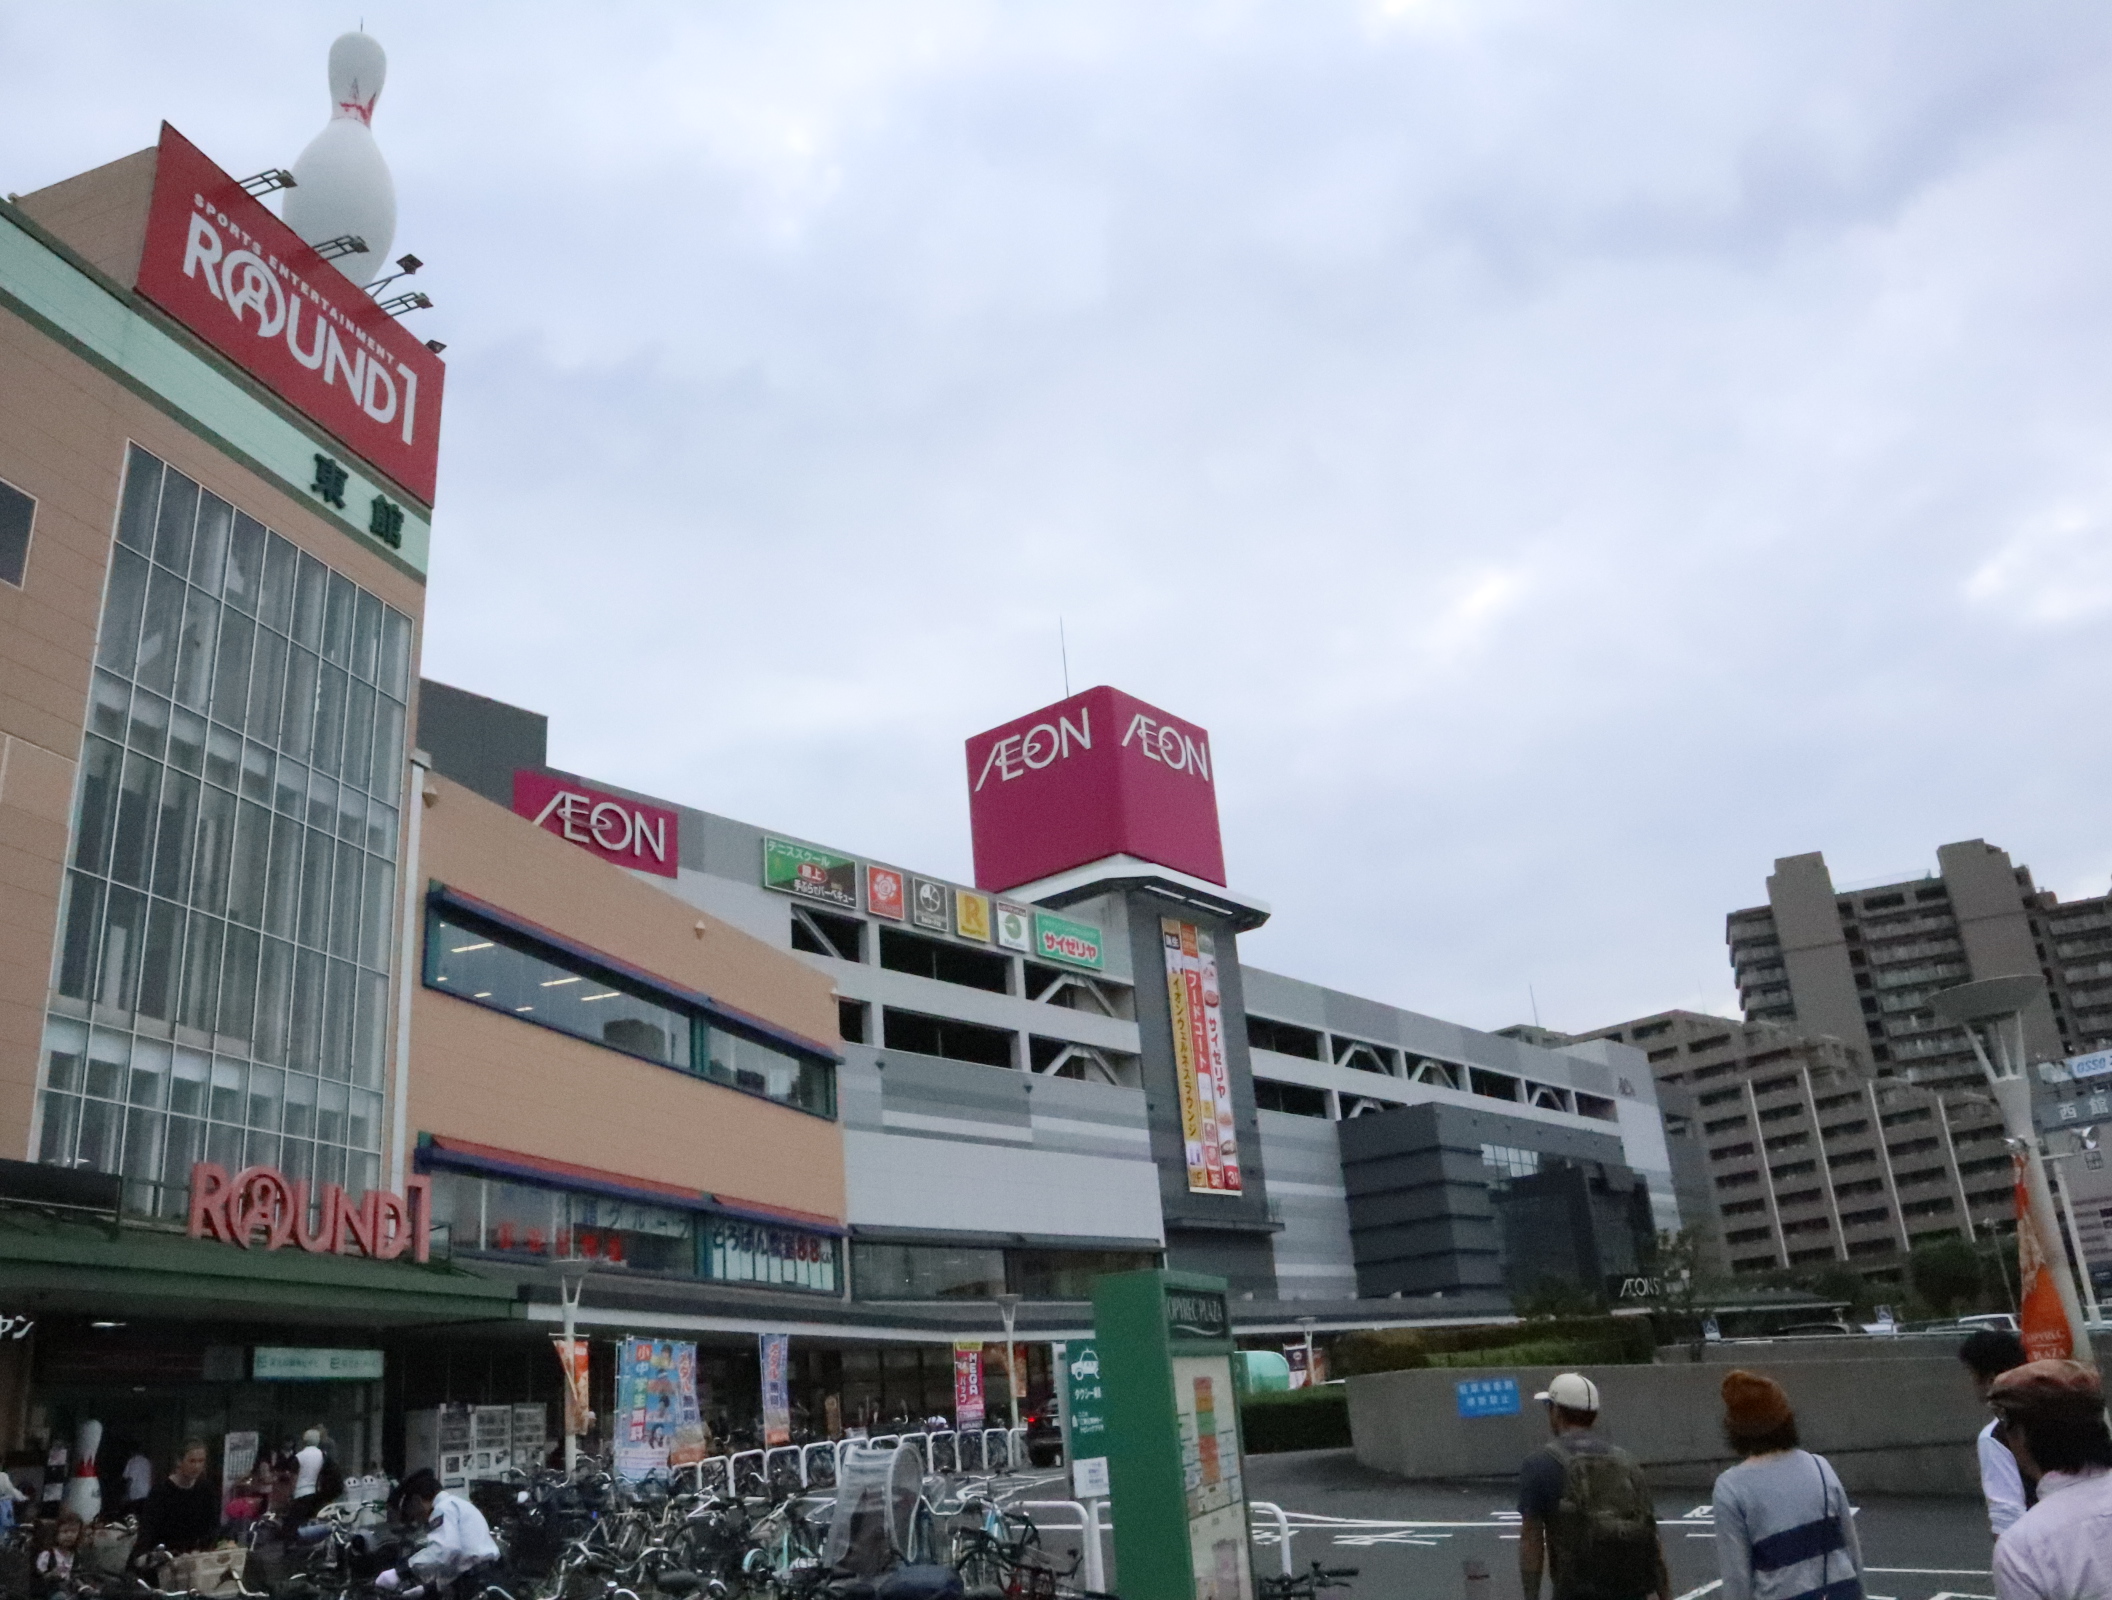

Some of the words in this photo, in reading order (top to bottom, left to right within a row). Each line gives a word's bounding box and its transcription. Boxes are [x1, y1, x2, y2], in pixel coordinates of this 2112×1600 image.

[194, 193, 261, 256] SPORTS
[269, 255, 394, 366] ENTERTAINMENT
[310, 453, 404, 550] 東館
[768, 841, 831, 867] テニススクール
[1044, 932, 1098, 960] サイゼリヤ
[1188, 973, 1207, 1070] フードコート
[1208, 1017, 1227, 1099] サイゼリヤ
[2058, 1097, 2109, 1121] 西館
[969, 1352, 979, 1395] MEGA
